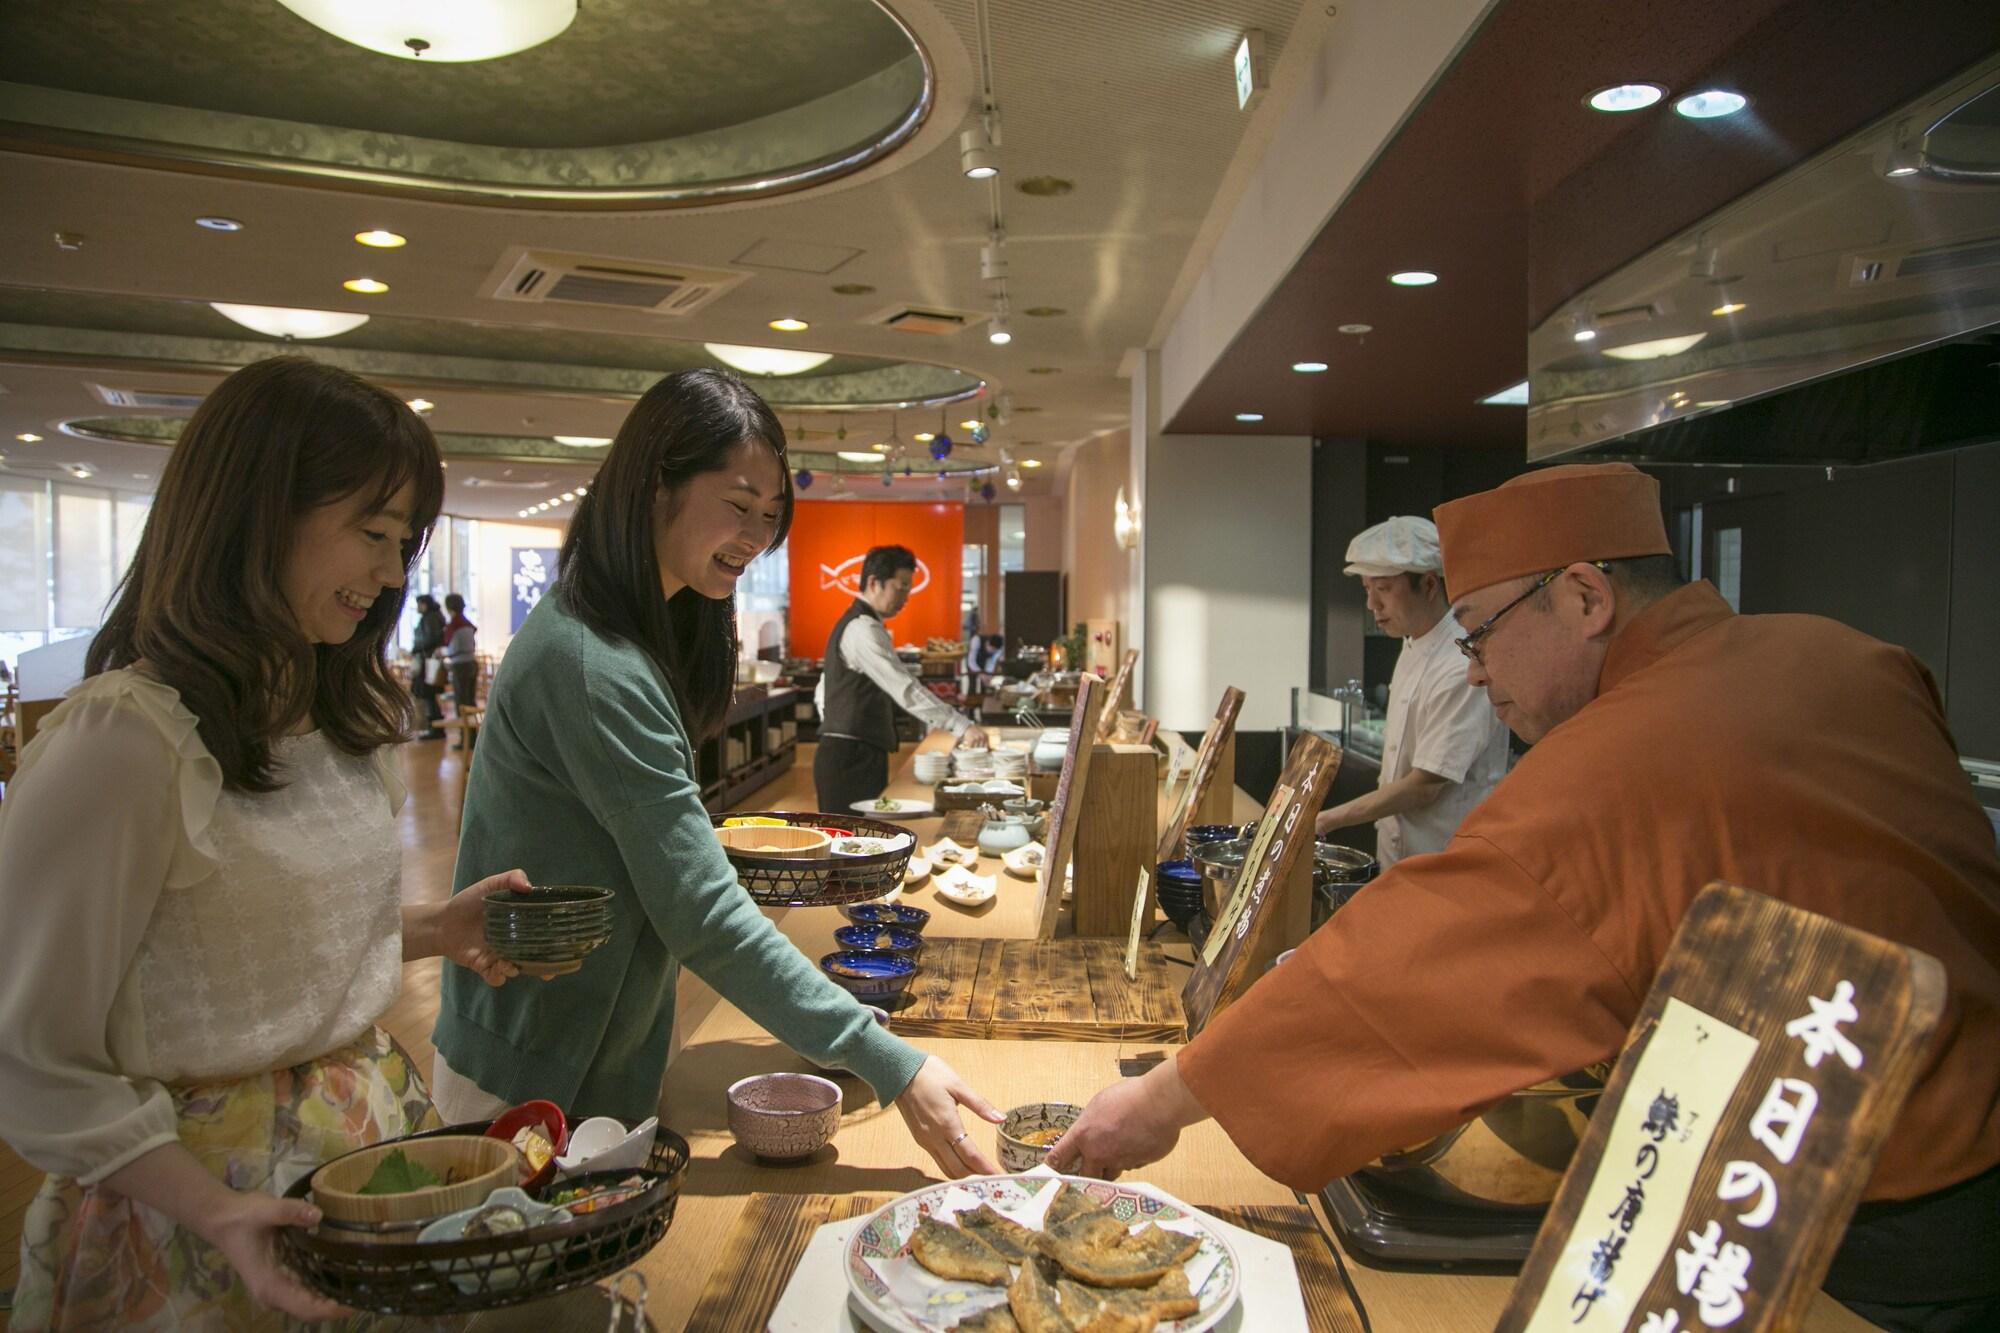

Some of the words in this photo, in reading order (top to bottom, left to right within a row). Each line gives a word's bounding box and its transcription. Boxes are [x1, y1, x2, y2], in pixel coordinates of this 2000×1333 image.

[1236, 761, 1319, 940] 本日の煮物
